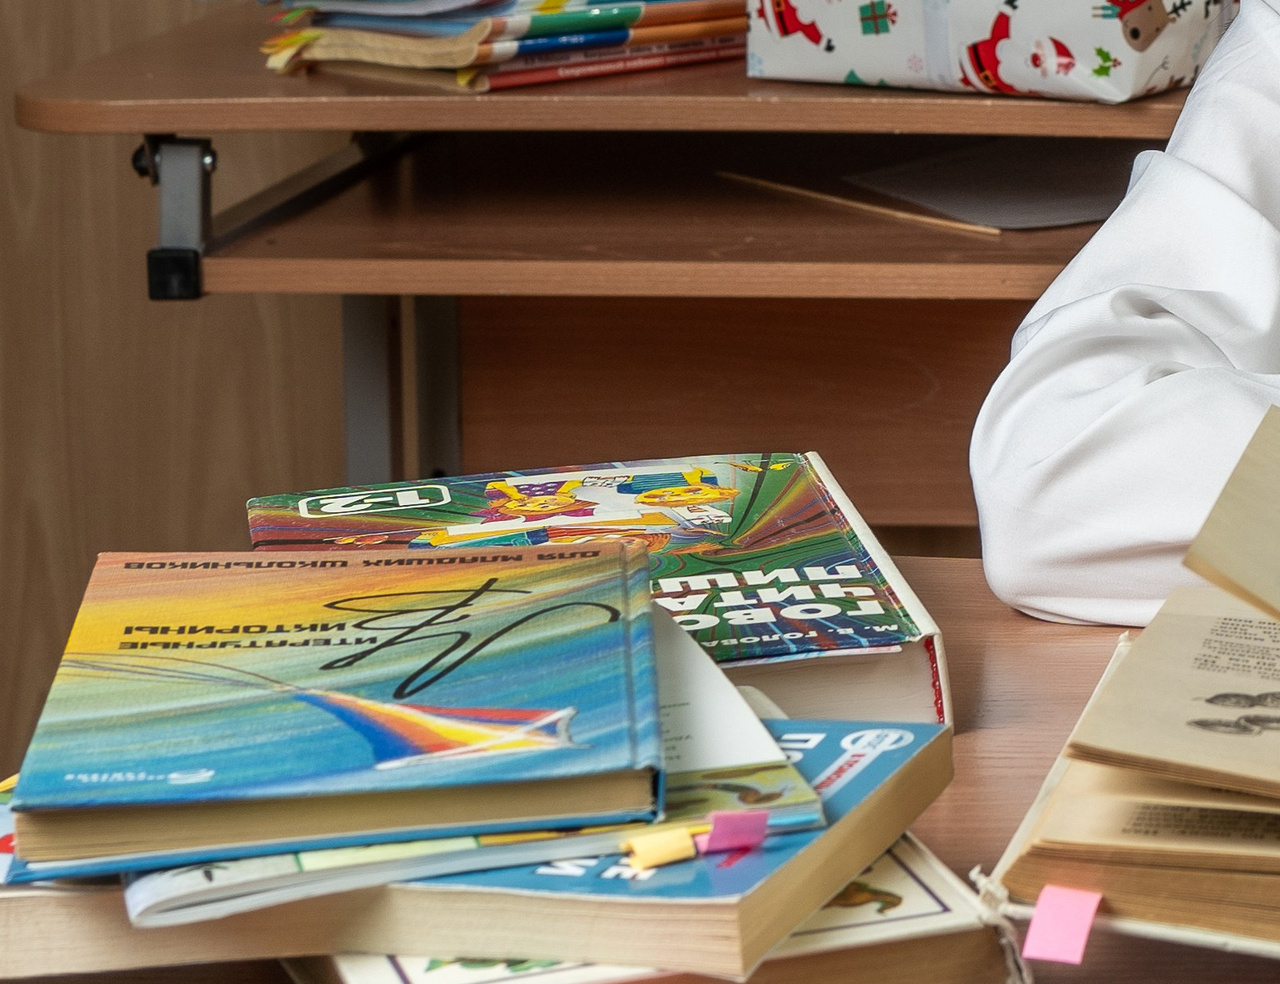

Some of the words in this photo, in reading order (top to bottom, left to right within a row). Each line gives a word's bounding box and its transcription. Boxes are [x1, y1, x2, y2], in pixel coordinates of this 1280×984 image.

[319, 490, 430, 514] 1-2
[362, 553, 524, 566] МЛАДШИХ
[537, 549, 602, 561] ДЛЯ
[123, 559, 349, 570] ШКОЛЬНИКОВ
[864, 623, 899, 633] М.
